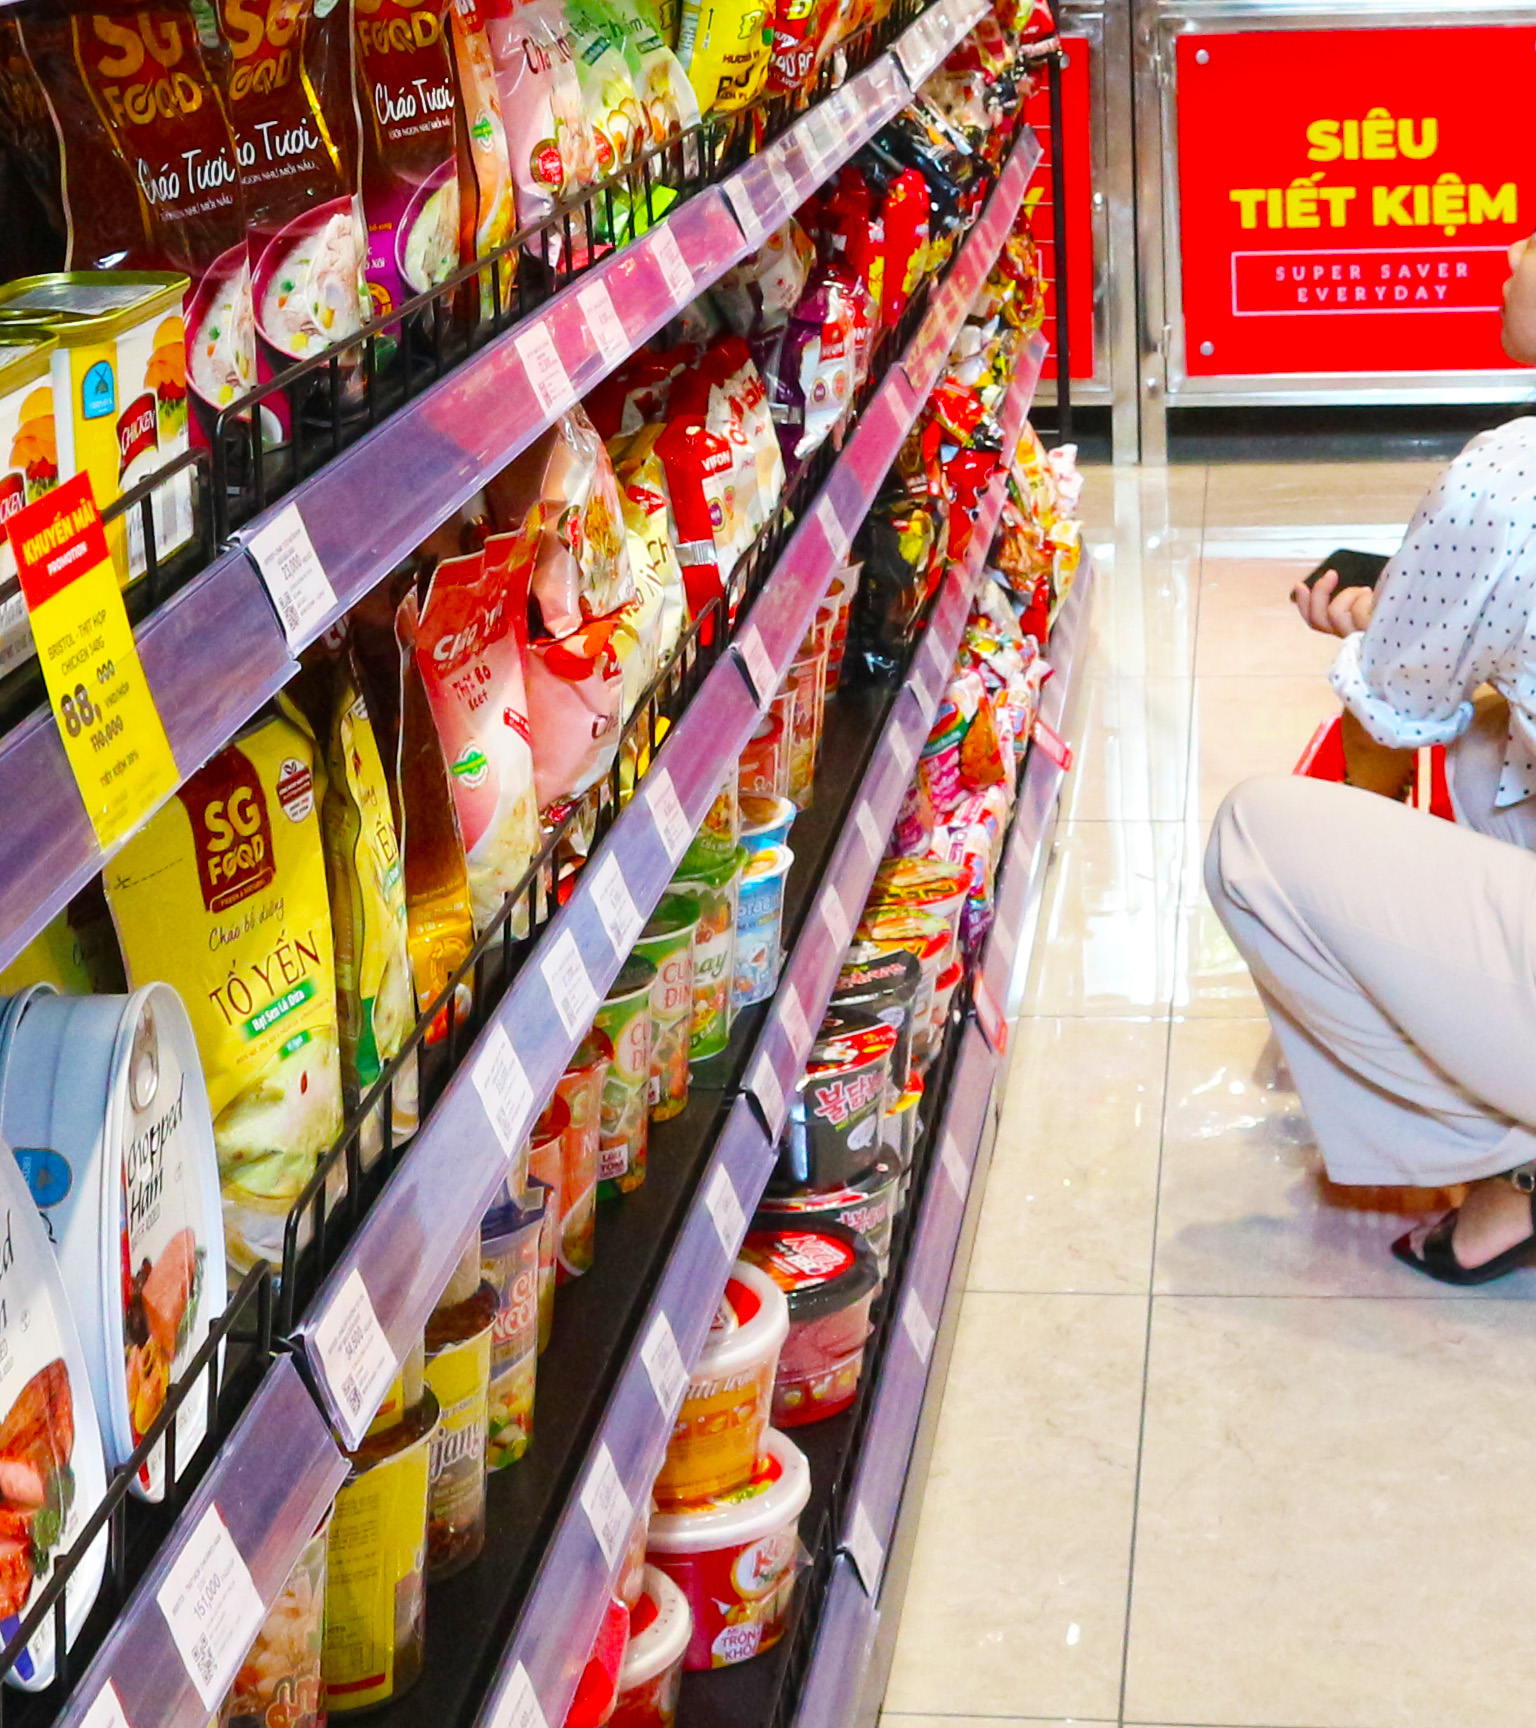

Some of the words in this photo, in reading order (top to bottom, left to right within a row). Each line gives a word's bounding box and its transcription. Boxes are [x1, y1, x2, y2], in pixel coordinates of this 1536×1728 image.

[95, 13, 185, 78] SG
[102, 76, 204, 127] FOOD
[1306, 107, 1439, 162] SIÊU
[1230, 171, 1359, 230] TIẾT
[1373, 172, 1518, 236] KIỆM
[1276, 262, 1370, 283] SUPER
[1381, 260, 1470, 280] SAVER
[1297, 284, 1451, 304] EVERYDAY
[700, 443, 732, 473] VIFON
[22, 513, 73, 566] KHUYẾN
[72, 497, 97, 533] MÃI
[47, 541, 88, 576] PROMOTION
[96, 658, 115, 684] 000
[203, 786, 260, 856] SG
[207, 837, 266, 886] FOOD
[251, 929, 321, 997] YẾN
[130, 1167, 163, 1231] Ham
